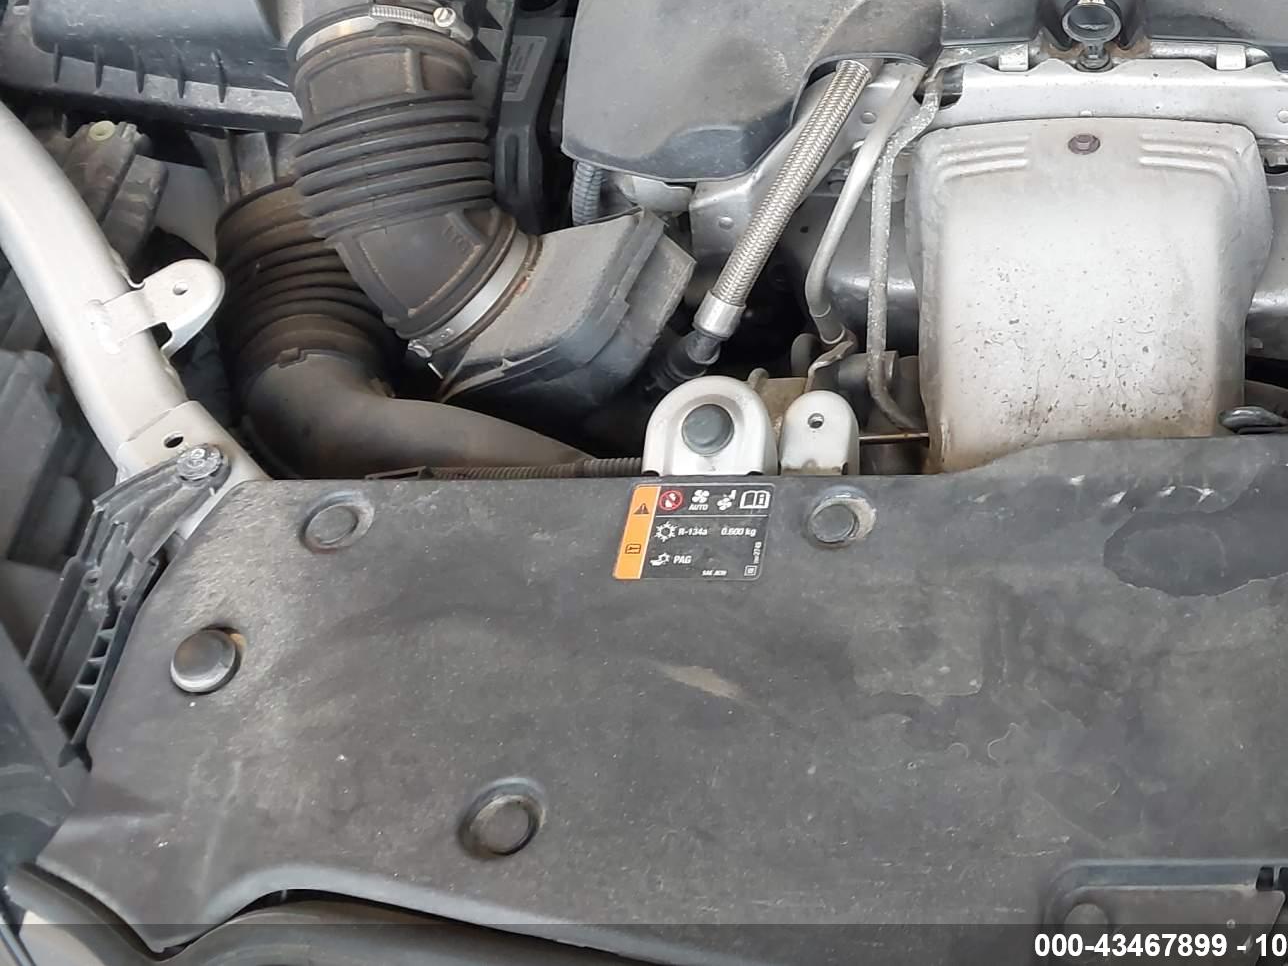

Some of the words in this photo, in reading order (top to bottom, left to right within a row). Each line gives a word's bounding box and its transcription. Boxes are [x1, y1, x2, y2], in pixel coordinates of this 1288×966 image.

[678, 527, 708, 536] R-134a
[745, 527, 757, 537] kg
[673, 555, 692, 564] PAG
